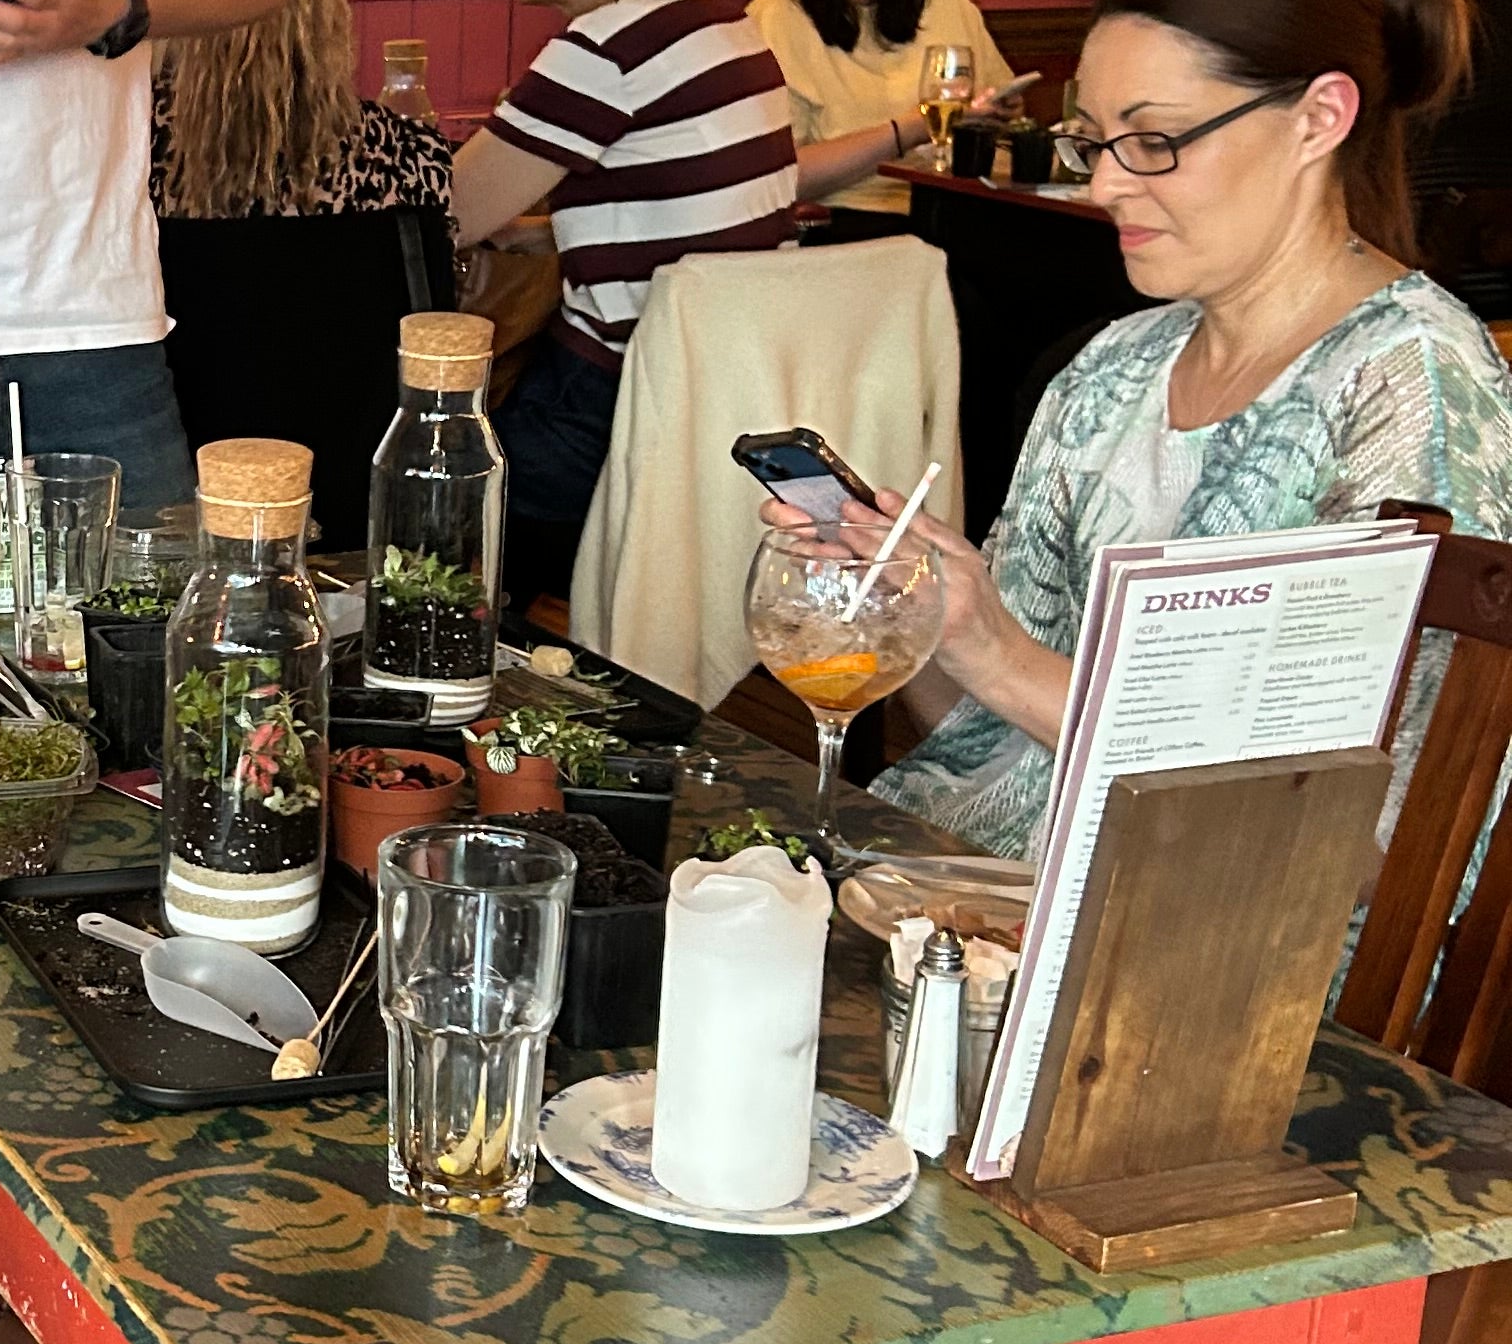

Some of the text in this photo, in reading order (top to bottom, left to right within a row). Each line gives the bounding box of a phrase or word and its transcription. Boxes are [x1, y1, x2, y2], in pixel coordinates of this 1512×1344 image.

[1141, 583, 1273, 614] DRINKS
[1136, 624, 1164, 635] ICED
[1268, 655, 1328, 673] HOMEMADE
[1108, 735, 1149, 748] COFFEE
